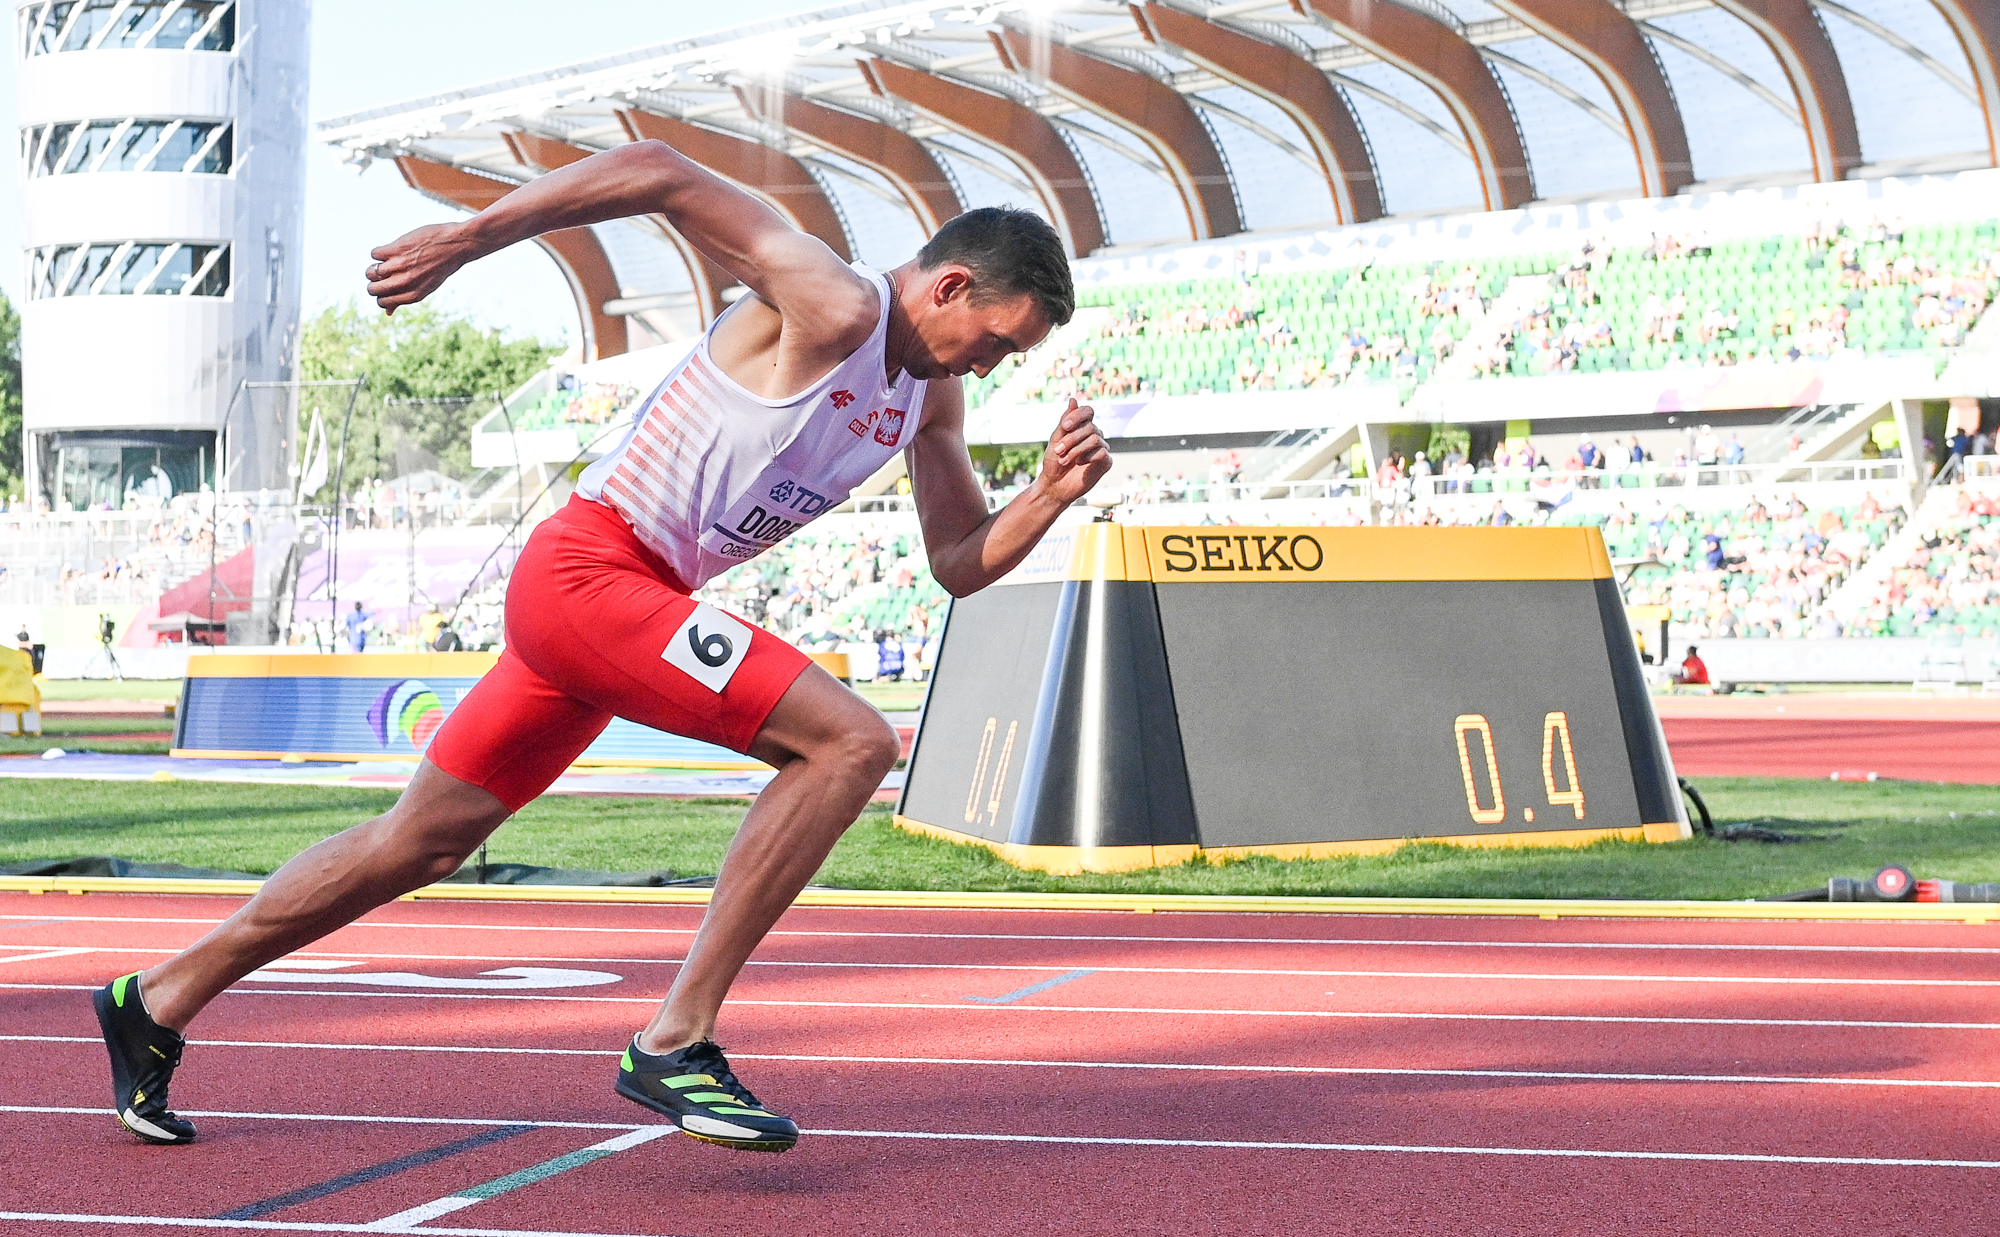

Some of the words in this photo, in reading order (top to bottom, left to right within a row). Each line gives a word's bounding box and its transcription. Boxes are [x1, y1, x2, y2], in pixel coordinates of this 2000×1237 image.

[829, 389, 856, 410] 4F
[1162, 534, 1323, 572] SEIKO
[688, 623, 734, 668] 6
[964, 717, 1019, 827] 0.4
[1454, 711, 1585, 824] 0.4
